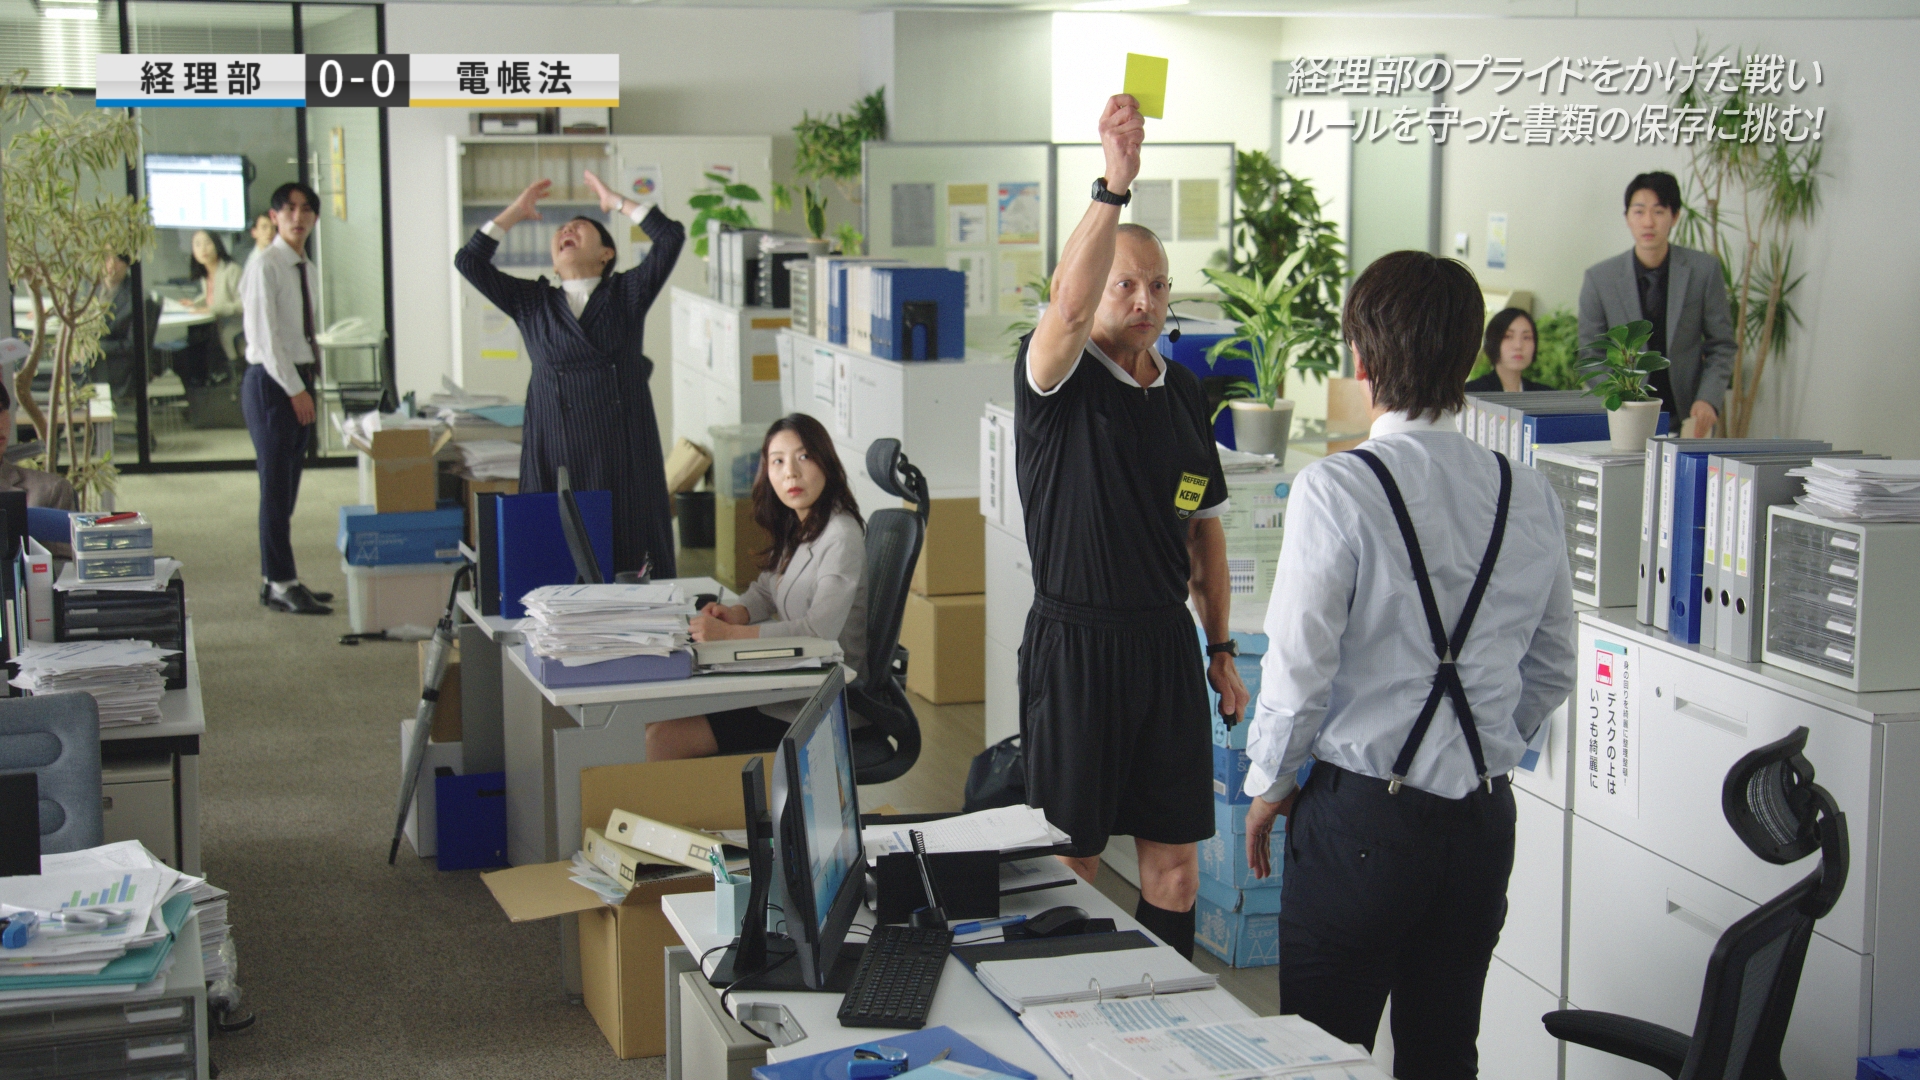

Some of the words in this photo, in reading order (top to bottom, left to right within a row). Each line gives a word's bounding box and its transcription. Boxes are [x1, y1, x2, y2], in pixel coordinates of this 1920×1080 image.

[1182, 475, 1206, 487] REFEREE
[1179, 489, 1201, 502] KEIRI
[1589, 688, 1600, 789] いつも綺麗に
[1606, 692, 1617, 795] デスクの上は
[1246, 938, 1279, 965] A4
